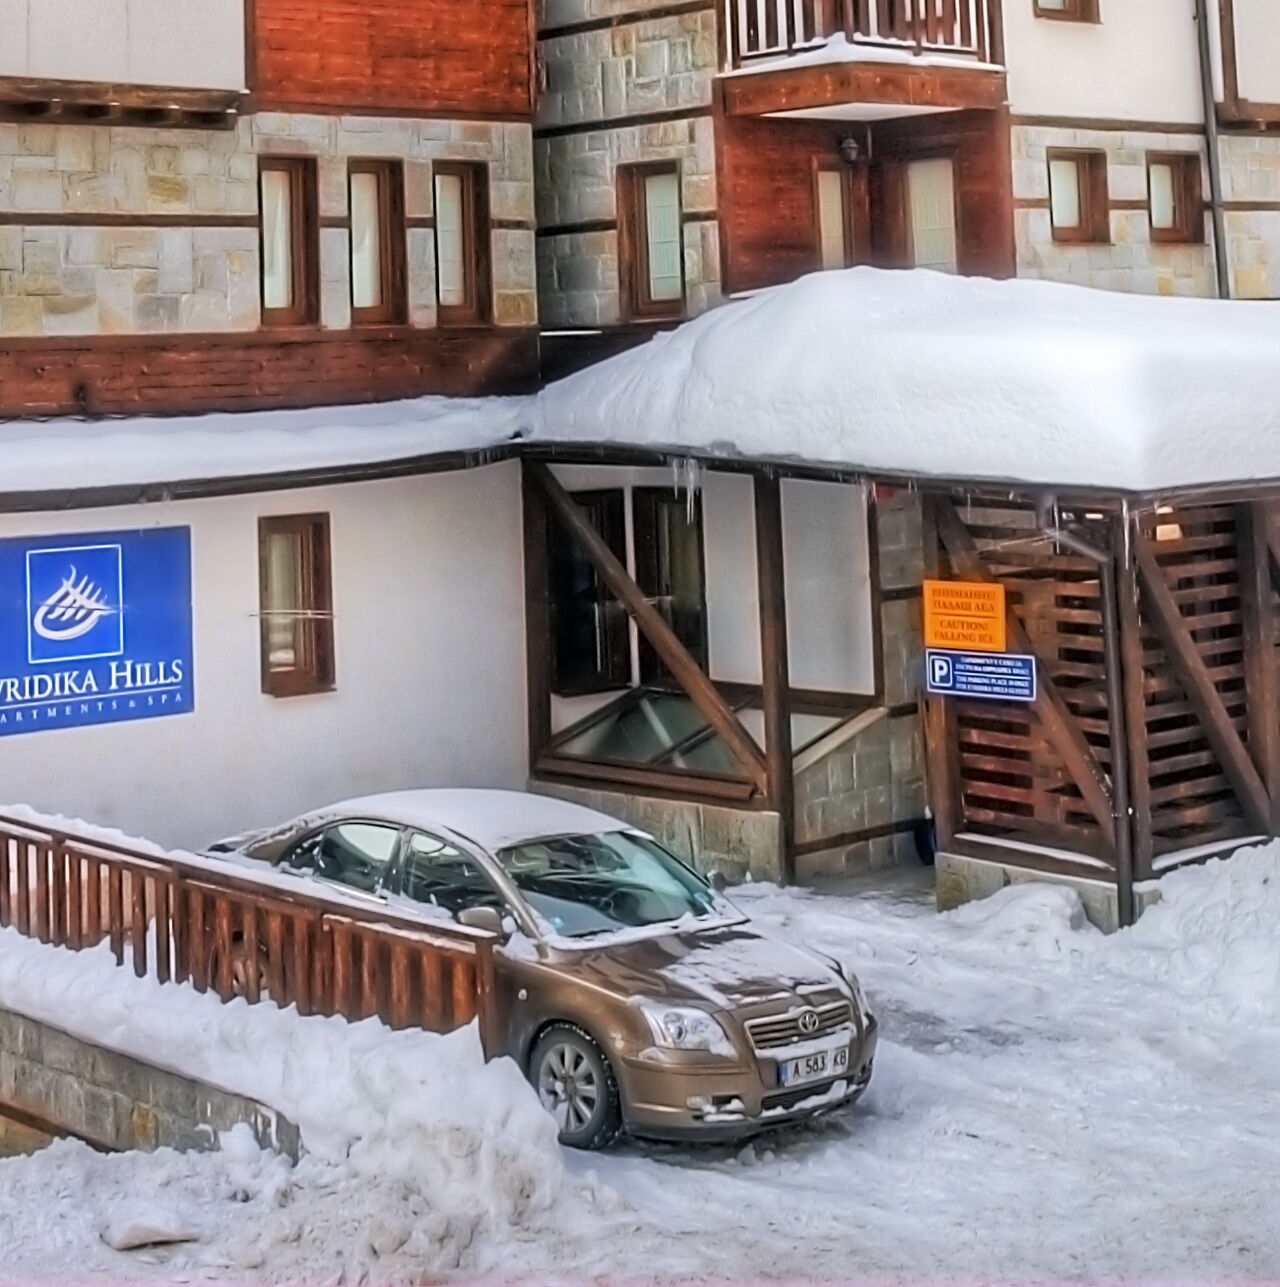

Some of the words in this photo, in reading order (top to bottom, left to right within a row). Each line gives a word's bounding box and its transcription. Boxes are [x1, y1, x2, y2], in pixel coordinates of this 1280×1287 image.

[108, 658, 183, 691] HILLS
[933, 658, 949, 683] P
[147, 692, 182, 707] SPA
[793, 1061, 800, 1080] A
[805, 1054, 825, 1074] 583
[833, 1048, 847, 1068] KB
